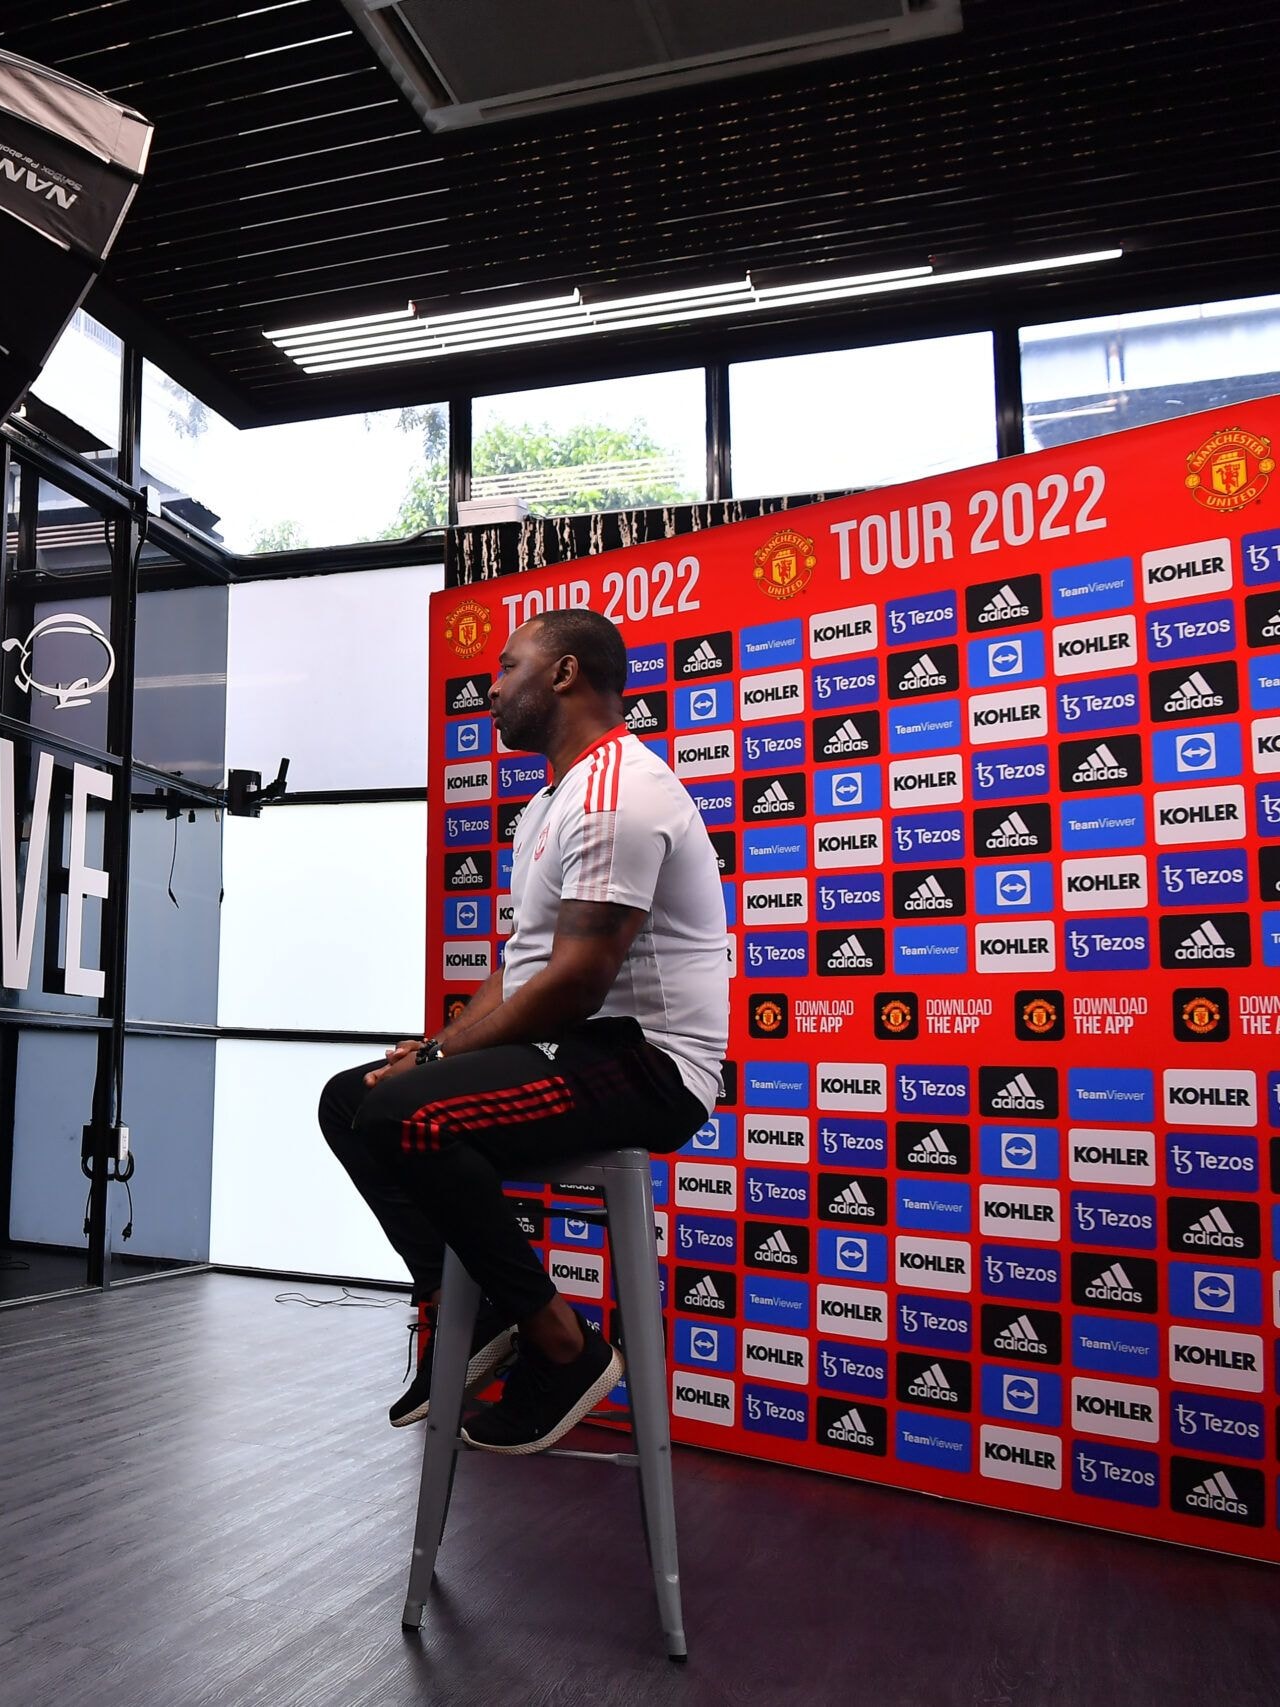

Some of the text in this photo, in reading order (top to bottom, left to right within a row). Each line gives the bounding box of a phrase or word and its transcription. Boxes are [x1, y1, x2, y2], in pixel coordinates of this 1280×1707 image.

[1193, 434, 1264, 467] MANCHESTER
[1206, 488, 1256, 506] UNITED
[830, 465, 1107, 581] TOUR 2022
[759, 533, 809, 562] MANCHESTER
[1149, 557, 1225, 584] KOHLER
[602, 555, 700, 625] 2022
[767, 579, 803, 595] UNITED
[1059, 580, 1124, 598] TeamViewer
[449, 605, 487, 625] MANCHESTER
[908, 608, 953, 625] Tezos
[978, 604, 1029, 623] adidas
[814, 620, 872, 642] KOHLER
[1174, 619, 1230, 639] Tezos
[455, 642, 482, 654] UNITED
[746, 638, 796, 653] TeamViewer
[1059, 633, 1130, 658] KOHLER
[629, 658, 664, 673] Tezos
[683, 657, 722, 673] adidas
[833, 674, 875, 691] Tezos
[899, 674, 946, 691] adidas
[453, 697, 484, 709] adidas
[744, 685, 799, 704] KOHLER
[1083, 694, 1135, 711] Tezos
[1164, 692, 1223, 712] adidas
[974, 704, 1041, 726] KOHLER
[896, 720, 954, 735] TeamViewer
[762, 738, 801, 752] Tezos
[824, 739, 868, 754] adidas
[678, 745, 729, 763] KOHLER
[513, 770, 544, 781] Tezos
[996, 763, 1045, 780] Tezos
[1072, 765, 1128, 783] adidas
[447, 775, 488, 789] KOHLER
[894, 771, 957, 791] KOHLER
[695, 797, 732, 809] Tezos
[753, 801, 795, 814] adidas
[1160, 804, 1239, 825] KOHLER
[460, 820, 489, 832] Tezos
[1069, 817, 1136, 831] TeamViewer
[818, 834, 878, 852] KOHLER
[915, 829, 960, 844] Tezos
[986, 834, 1038, 848] adidas
[749, 845, 800, 855] TeamViewer
[452, 873, 483, 884] adidas
[1068, 873, 1141, 892] KOHLER
[1186, 868, 1243, 884] Tezos
[747, 894, 802, 909] KOHLER
[837, 889, 880, 904] Tezos
[905, 896, 953, 910] adidas
[900, 945, 959, 956] TeamViewer
[981, 938, 1049, 954] KOHLER
[1092, 935, 1145, 951] Tezos
[1175, 944, 1235, 959] adidas
[446, 955, 487, 967] KOHLER
[765, 946, 805, 960] Tezos
[827, 955, 872, 968] adidas
[795, 1000, 854, 1015] DOWNLOAD
[926, 999, 992, 1015] DOWNLOAD
[1073, 997, 1147, 1015] DOWNLOAD
[795, 1017, 843, 1032] THE APP
[926, 1017, 979, 1033] THE APP
[1074, 1016, 1134, 1034] THE APP
[1239, 1015, 1271, 1035] THE
[750, 1080, 802, 1090] TeamViewer
[821, 1078, 881, 1094] KOHLER
[919, 1080, 966, 1097] Tezos
[992, 1097, 1044, 1110] adidas
[1076, 1089, 1144, 1101] TeamViewer
[1170, 1087, 1251, 1106] KOHLER
[748, 1129, 804, 1146] KOHLER
[840, 1133, 883, 1150] Tezos
[908, 1150, 957, 1165] adidas
[1074, 1147, 1149, 1166] KOHLER
[1195, 1152, 1254, 1171] Tezos
[679, 1177, 732, 1195] KOHLER
[766, 1185, 806, 1200] Tezos
[829, 1202, 875, 1216] adidas
[903, 1199, 963, 1213] TeamViewer
[984, 1201, 1054, 1222] KOHLER
[1098, 1209, 1152, 1229] Tezos
[694, 1231, 733, 1247] Tezos
[1183, 1232, 1244, 1247] adidas
[754, 1250, 798, 1264] adidas
[900, 1253, 965, 1274] KOHLER
[552, 1264, 599, 1283] KOHLER
[1006, 1262, 1057, 1283] Tezos
[685, 1294, 725, 1309] adidas
[750, 1294, 802, 1310] TeamViewer
[1085, 1286, 1142, 1302] adidas
[821, 1300, 882, 1322] KOHLER
[920, 1312, 967, 1333] Tezos
[994, 1337, 1047, 1354] adidas
[1080, 1337, 1149, 1355] TeamViewer
[746, 1345, 804, 1367] KOHLER
[1174, 1344, 1257, 1372] KOHLER
[840, 1358, 883, 1379] Tezos
[676, 1386, 730, 1409] KOHLER
[908, 1384, 958, 1402] adidas
[763, 1401, 804, 1422] Tezos
[1076, 1395, 1154, 1423] KOHLER
[1200, 1412, 1260, 1437] Tezos
[828, 1428, 874, 1446] adidas
[902, 1431, 963, 1451] TeamViewer
[985, 1442, 1056, 1470] KOHLER
[1100, 1461, 1155, 1486] Tezos
[1186, 1494, 1248, 1515] adidas
